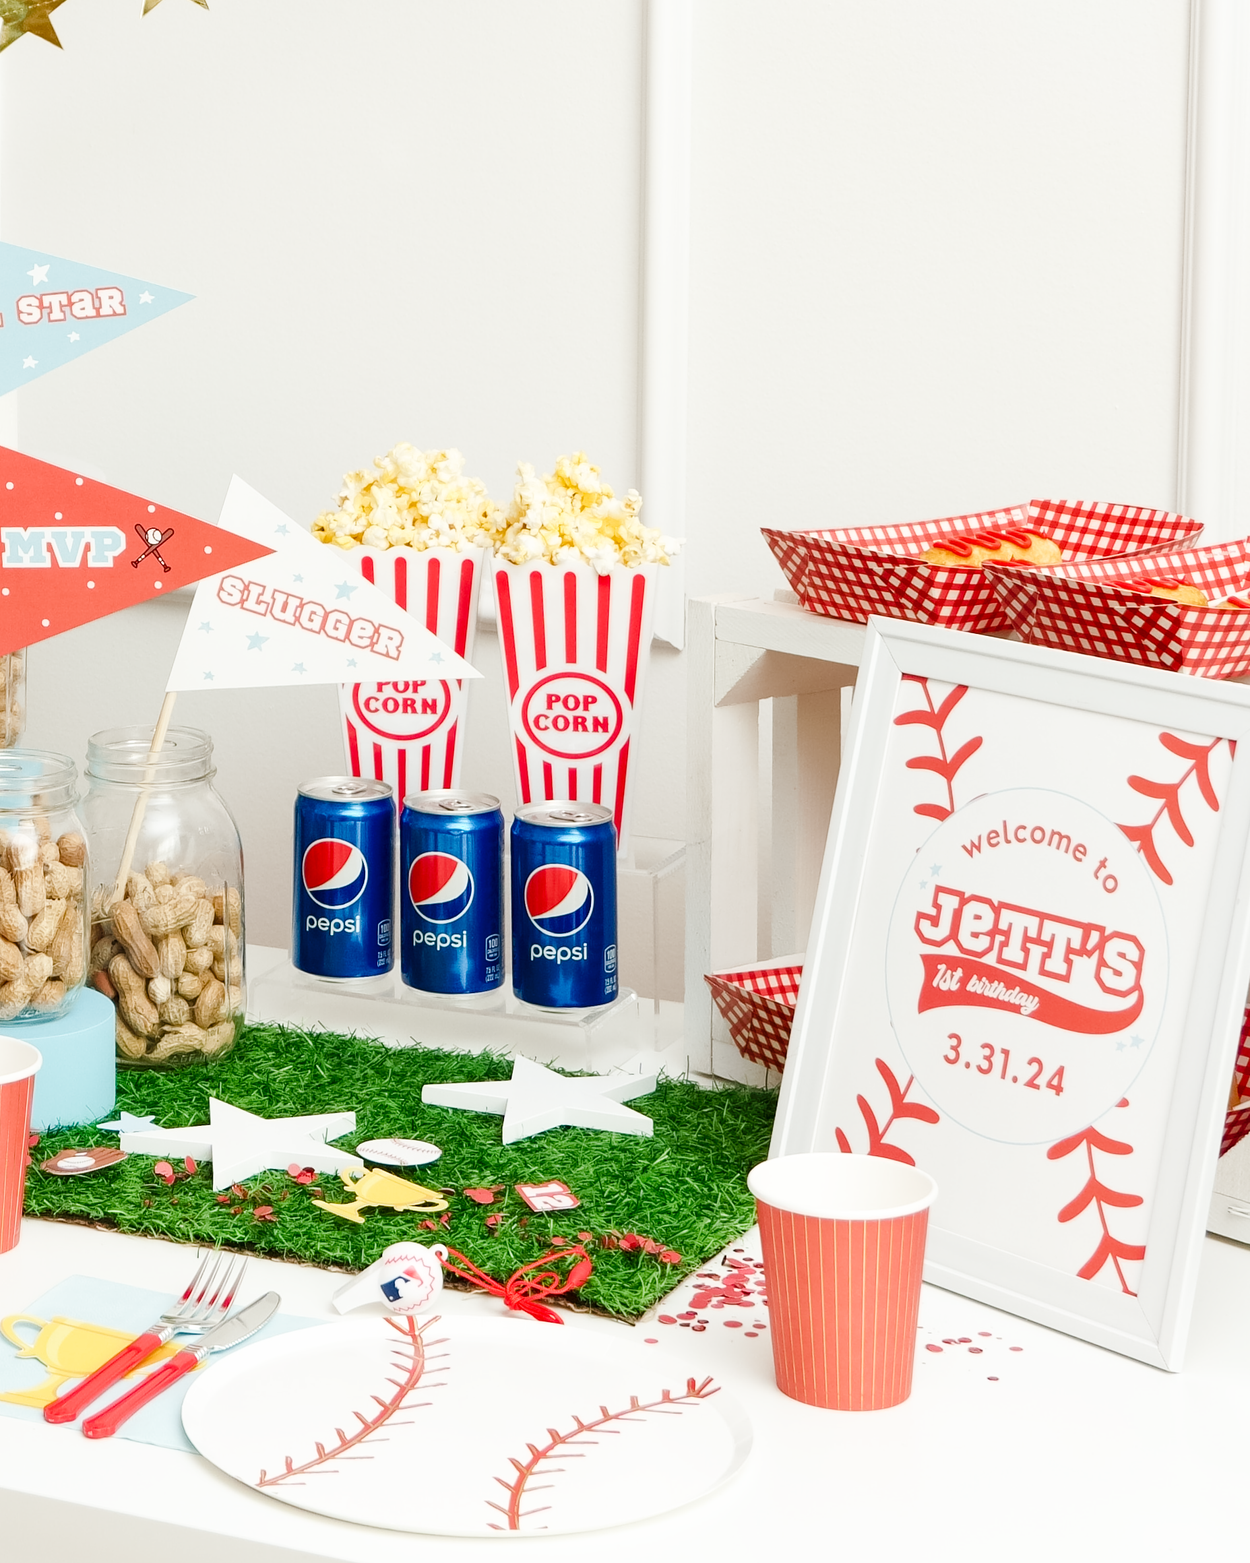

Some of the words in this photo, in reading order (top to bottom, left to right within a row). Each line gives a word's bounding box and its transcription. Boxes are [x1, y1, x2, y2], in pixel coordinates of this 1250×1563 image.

[0, 526, 126, 568] MVP
[363, 696, 438, 715] CORN
[545, 693, 598, 712] POP
[533, 715, 611, 734] CORN
[961, 820, 1088, 863] welcome
[1093, 856, 1119, 894] to
[305, 914, 361, 936] pepsi
[412, 929, 468, 951] pepsi
[530, 942, 589, 965] pepsi
[932, 963, 963, 992] 1st
[966, 974, 1040, 1015] birthday
[943, 1033, 1066, 1097] 3.31.24
[521, 1182, 574, 1210] 12
